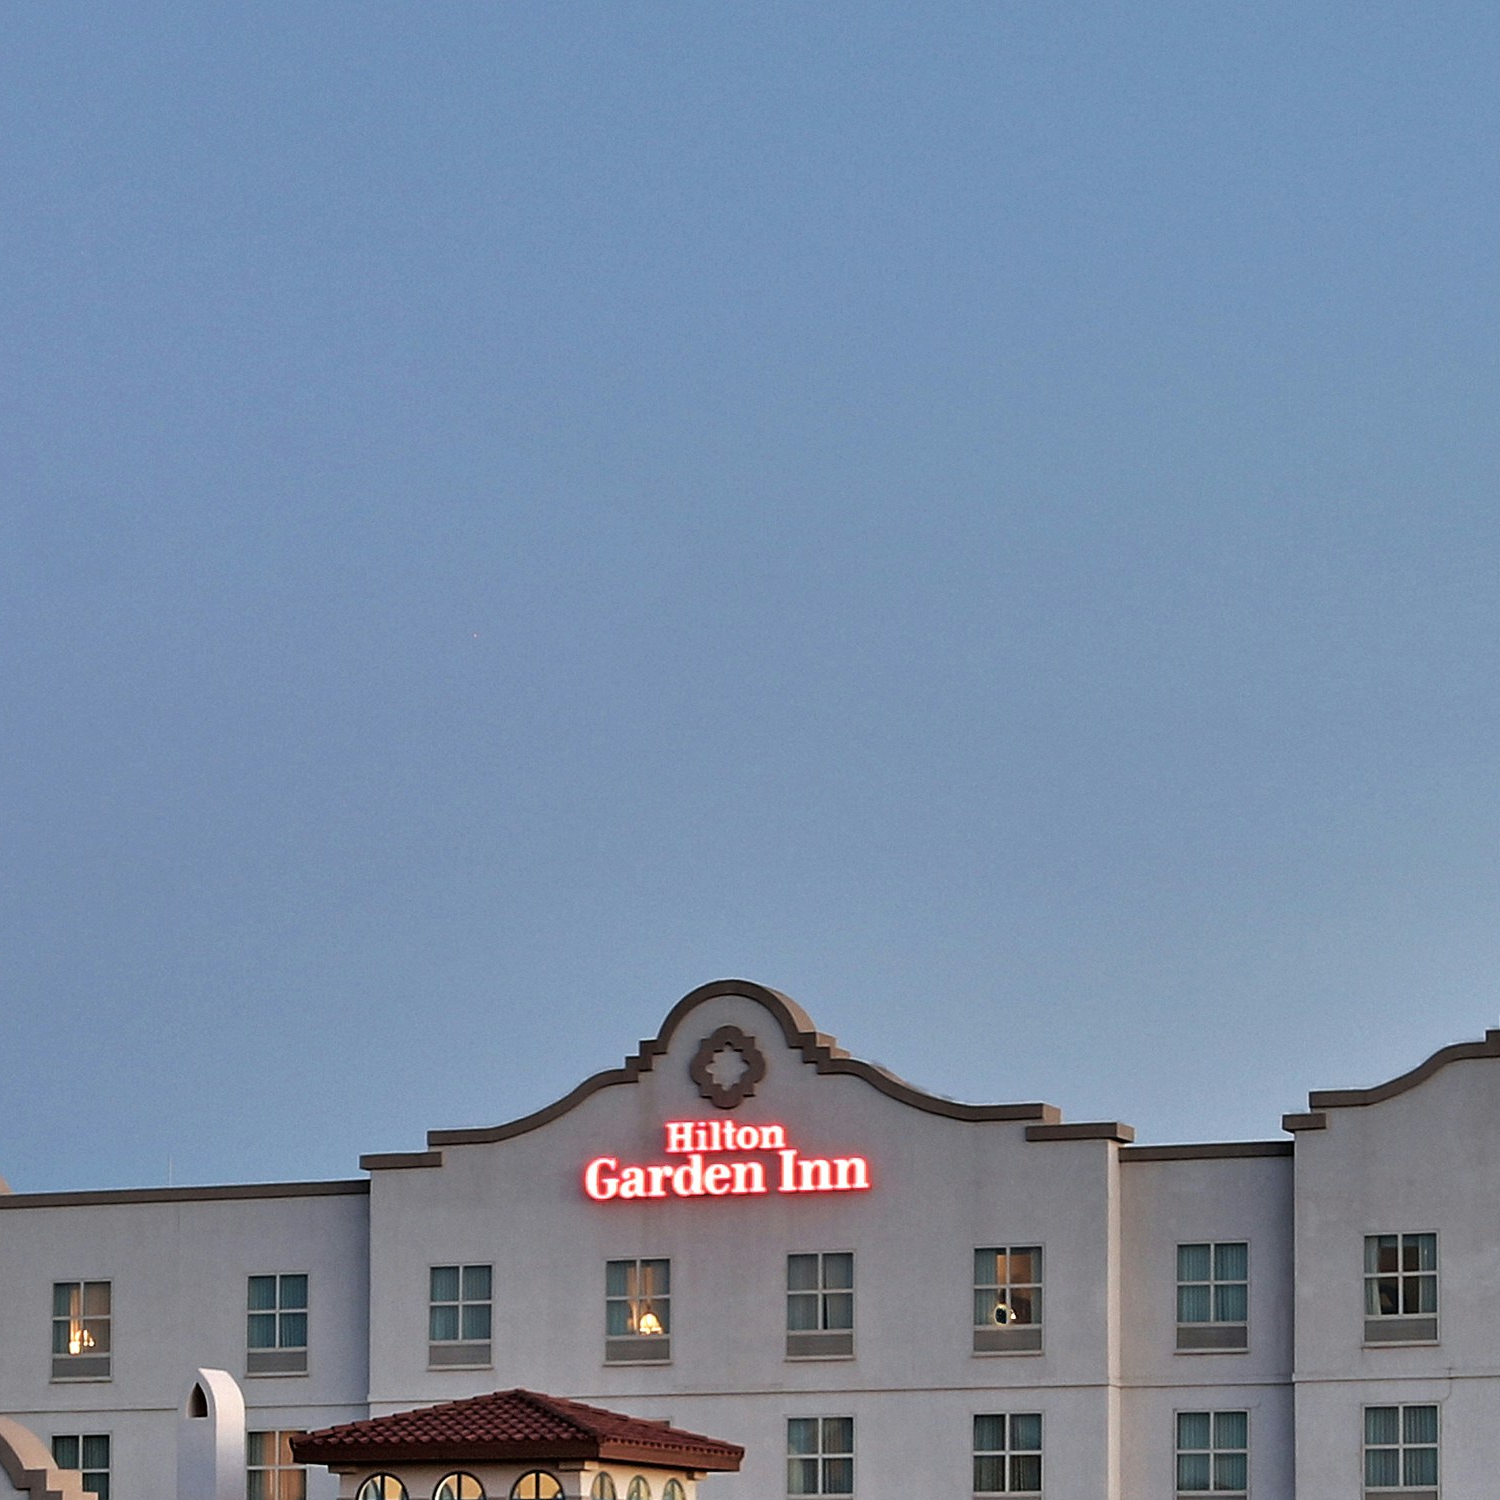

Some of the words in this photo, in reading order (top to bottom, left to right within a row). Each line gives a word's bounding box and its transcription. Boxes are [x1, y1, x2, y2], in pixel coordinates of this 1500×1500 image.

[665, 1120, 785, 1153] Hilton
[585, 1154, 767, 1200] Garden
[777, 1149, 870, 1192] Inn
